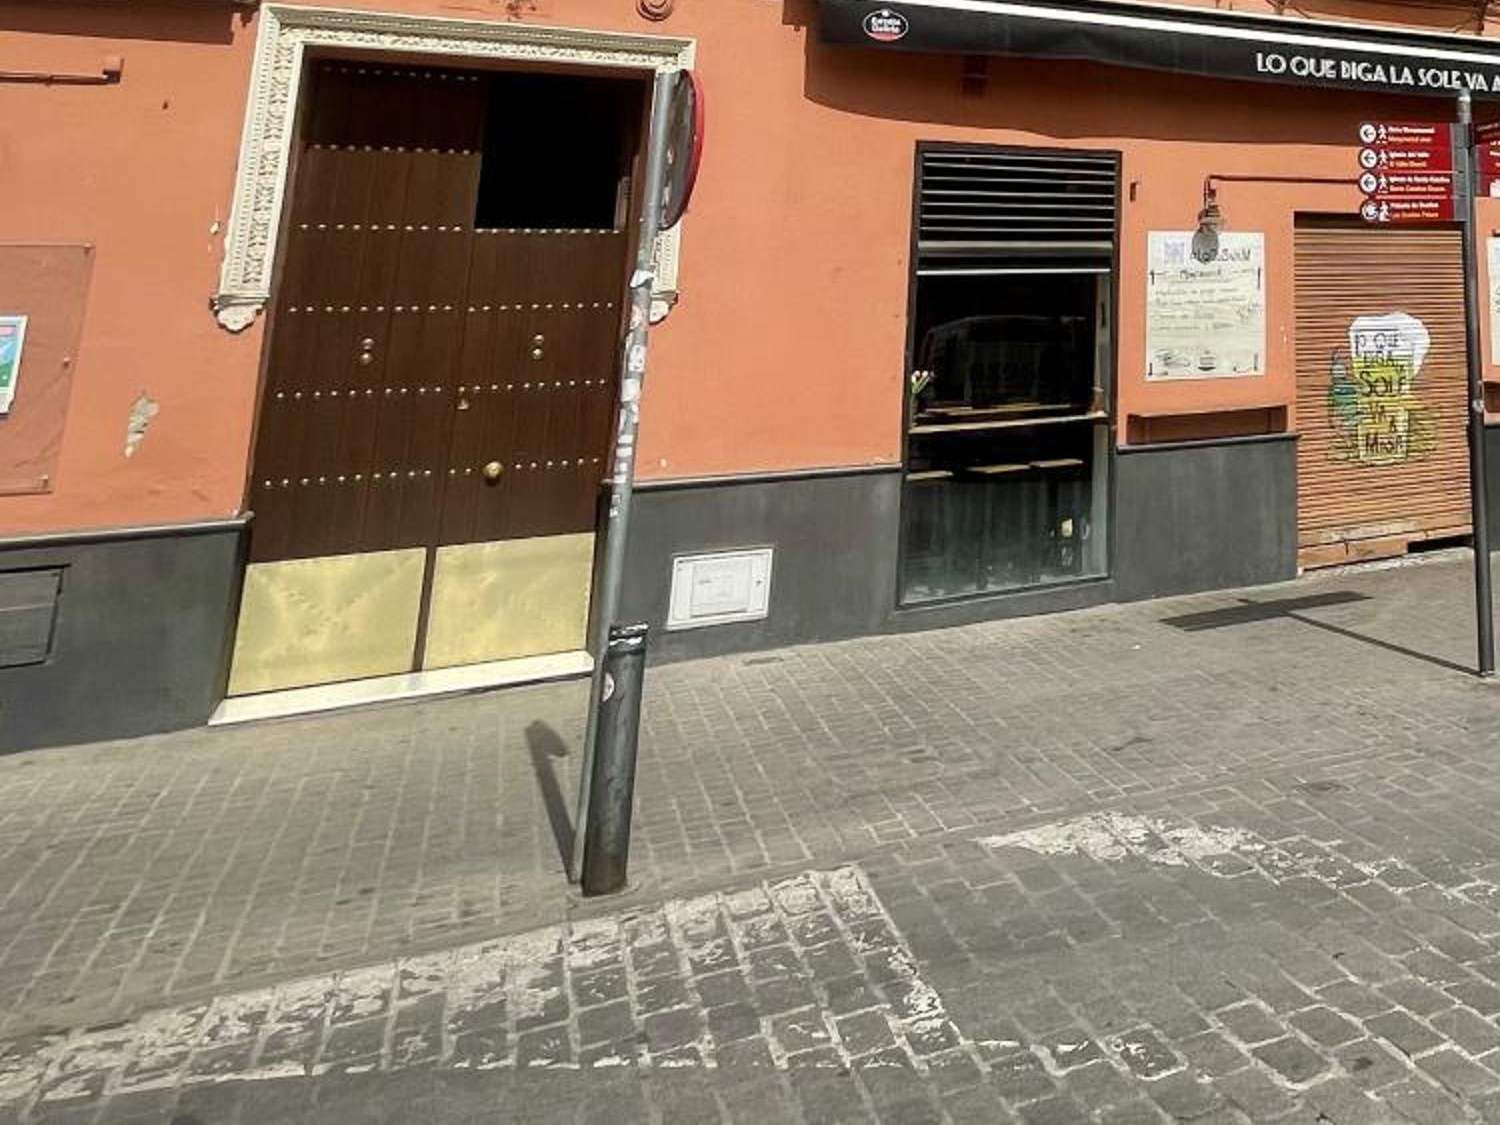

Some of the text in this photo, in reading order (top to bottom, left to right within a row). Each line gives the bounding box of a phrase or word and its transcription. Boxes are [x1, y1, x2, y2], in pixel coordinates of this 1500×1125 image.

[1256, 52, 1287, 74] LO
[1290, 56, 1336, 78] QUE
[1341, 60, 1387, 83] DIGA
[1390, 66, 1414, 86] LA
[1418, 69, 1461, 90] SOLE
[1464, 72, 1488, 91] VA
